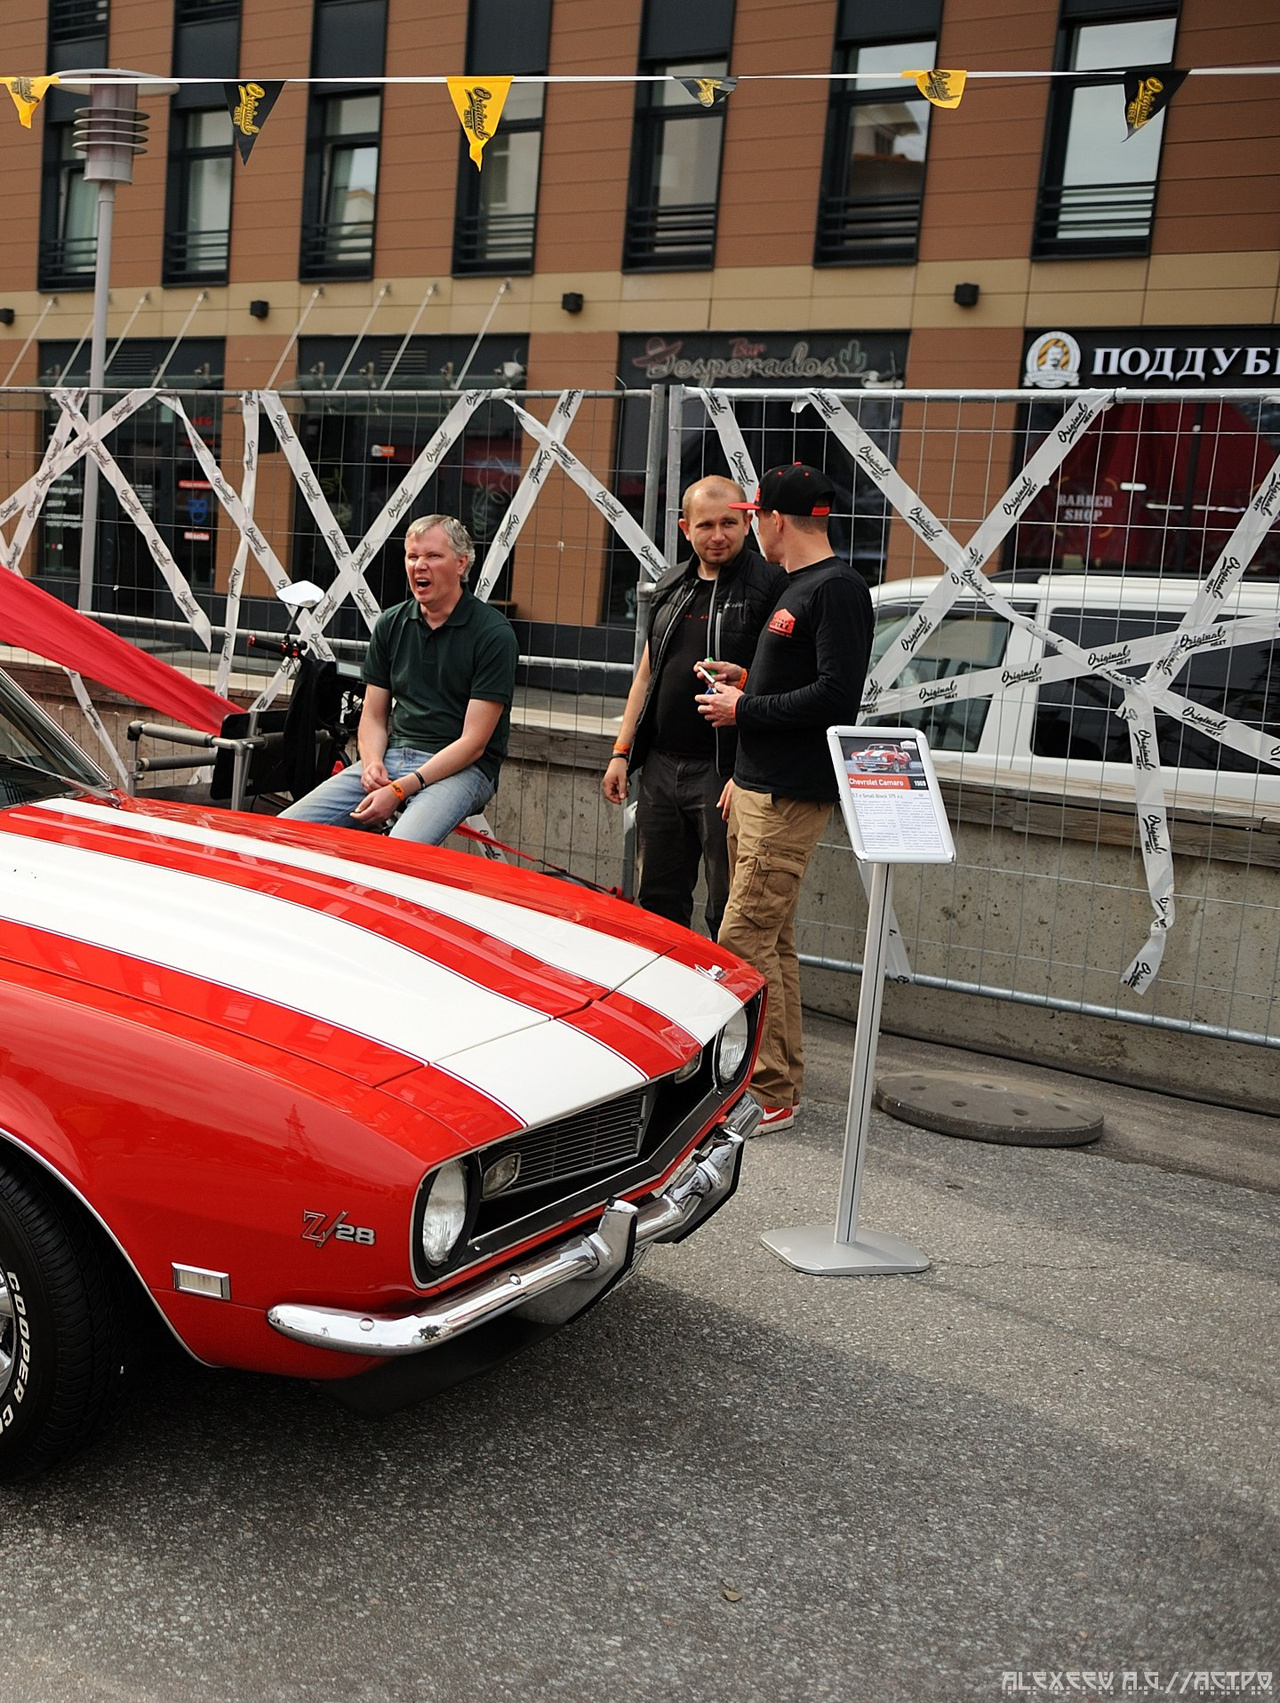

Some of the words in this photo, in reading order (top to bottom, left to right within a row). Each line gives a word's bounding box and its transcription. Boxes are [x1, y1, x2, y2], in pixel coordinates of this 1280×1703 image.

[237, 82, 266, 136] Original
[464, 86, 493, 141] Original
[646, 341, 840, 388] Desperados
[1057, 402, 1089, 444] Original
[426, 431, 448, 464] Original
[857, 445, 892, 477] Original
[730, 451, 755, 486] Original
[299, 471, 322, 500] Original
[1002, 476, 1033, 517] Original
[1058, 494, 1113, 508] BARBER
[387, 486, 409, 519] Original
[595, 490, 624, 519] Original
[1064, 509, 1103, 522] SHOP
[503, 513, 520, 549] Original
[908, 506, 943, 538] Original
[326, 529, 350, 558] Original
[638, 545, 669, 573] Original
[960, 568, 996, 601] Original
[1213, 556, 1241, 600] Original
[900, 614, 928, 653] Original
[1180, 625, 1226, 651] Original
[1087, 644, 1131, 671] Original
[919, 680, 958, 704] Original
[1001, 663, 1042, 688] Original
[1182, 706, 1228, 732] Original
[1134, 729, 1157, 771] Original
[848, 777, 878, 787] Chevrolet
[880, 779, 904, 787] Camaro
[1142, 814, 1168, 855] Original
[301, 1208, 377, 1248] Z/28
[6, 1271, 31, 1404] COOPER
